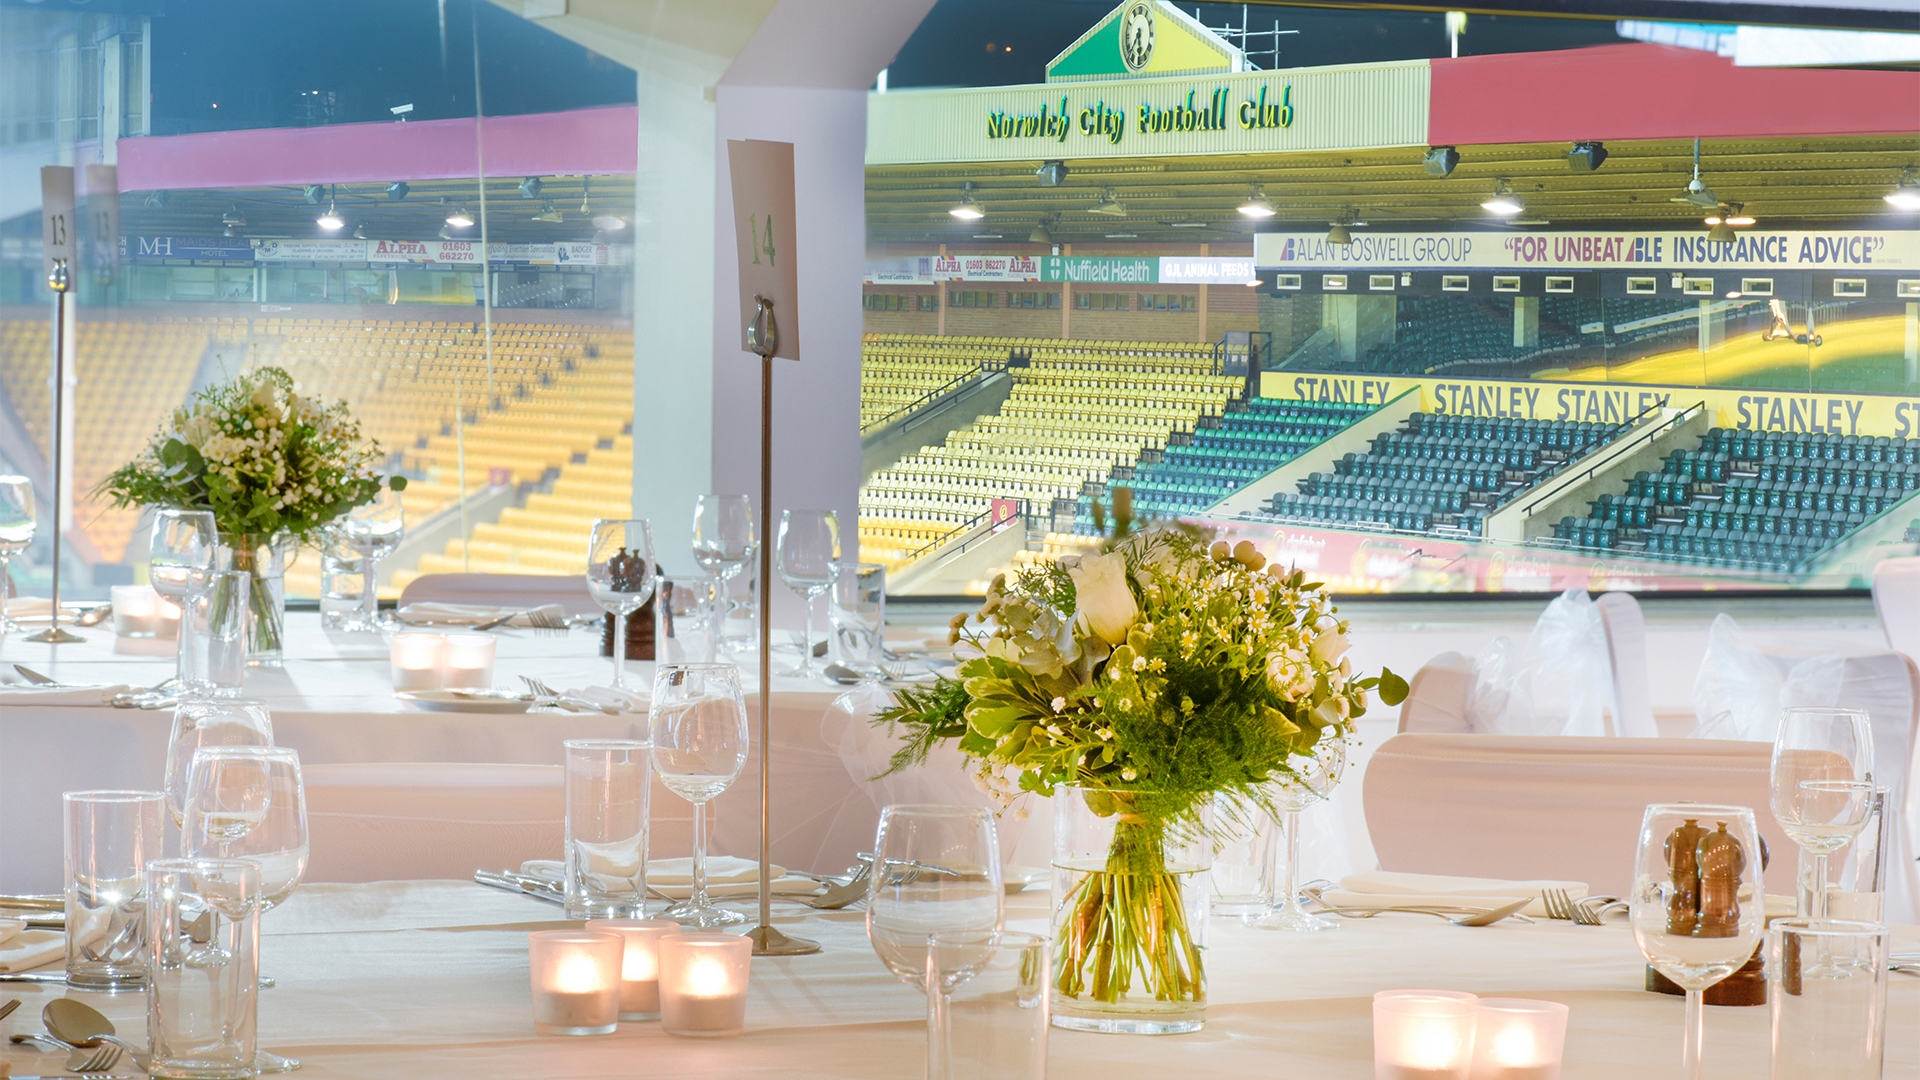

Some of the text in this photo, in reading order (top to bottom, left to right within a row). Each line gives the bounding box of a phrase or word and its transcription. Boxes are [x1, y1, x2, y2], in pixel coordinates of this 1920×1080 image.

[985, 84, 1295, 144] Norwich City Football Club
[52, 214, 66, 246] 13
[137, 236, 173, 256] MH
[175, 237, 216, 247] MAIDS
[442, 242, 472, 251] 01603
[749, 212, 775, 267] 14
[376, 240, 428, 255] ALPHA
[508, 244, 530, 254] Erection
[530, 244, 556, 255] Specialists
[571, 246, 592, 254] BADGER
[1296, 237, 1472, 262] ALAN BOSWELL GROUP
[1554, 236, 1662, 263] UNBEATABLE
[1673, 235, 1788, 263] INSURANCE
[439, 252, 475, 261] 662270
[935, 258, 962, 273] ALPHA
[966, 260, 1006, 270] 01603 662270
[1009, 258, 1037, 273] ALPHA
[1064, 260, 1150, 282] Nuffield Health
[1165, 263, 1181, 278] GJL
[1183, 263, 1219, 278] ANIMAL
[1220, 262, 1249, 277] FEEDS
[893, 273, 913, 281] Contractors
[1293, 376, 1390, 405] STANLEY
[1434, 383, 1540, 418] STANLEY
[1556, 388, 1671, 425] STANLEY
[1737, 395, 1864, 435] STANLEY
[1286, 533, 1327, 548] dafabet
